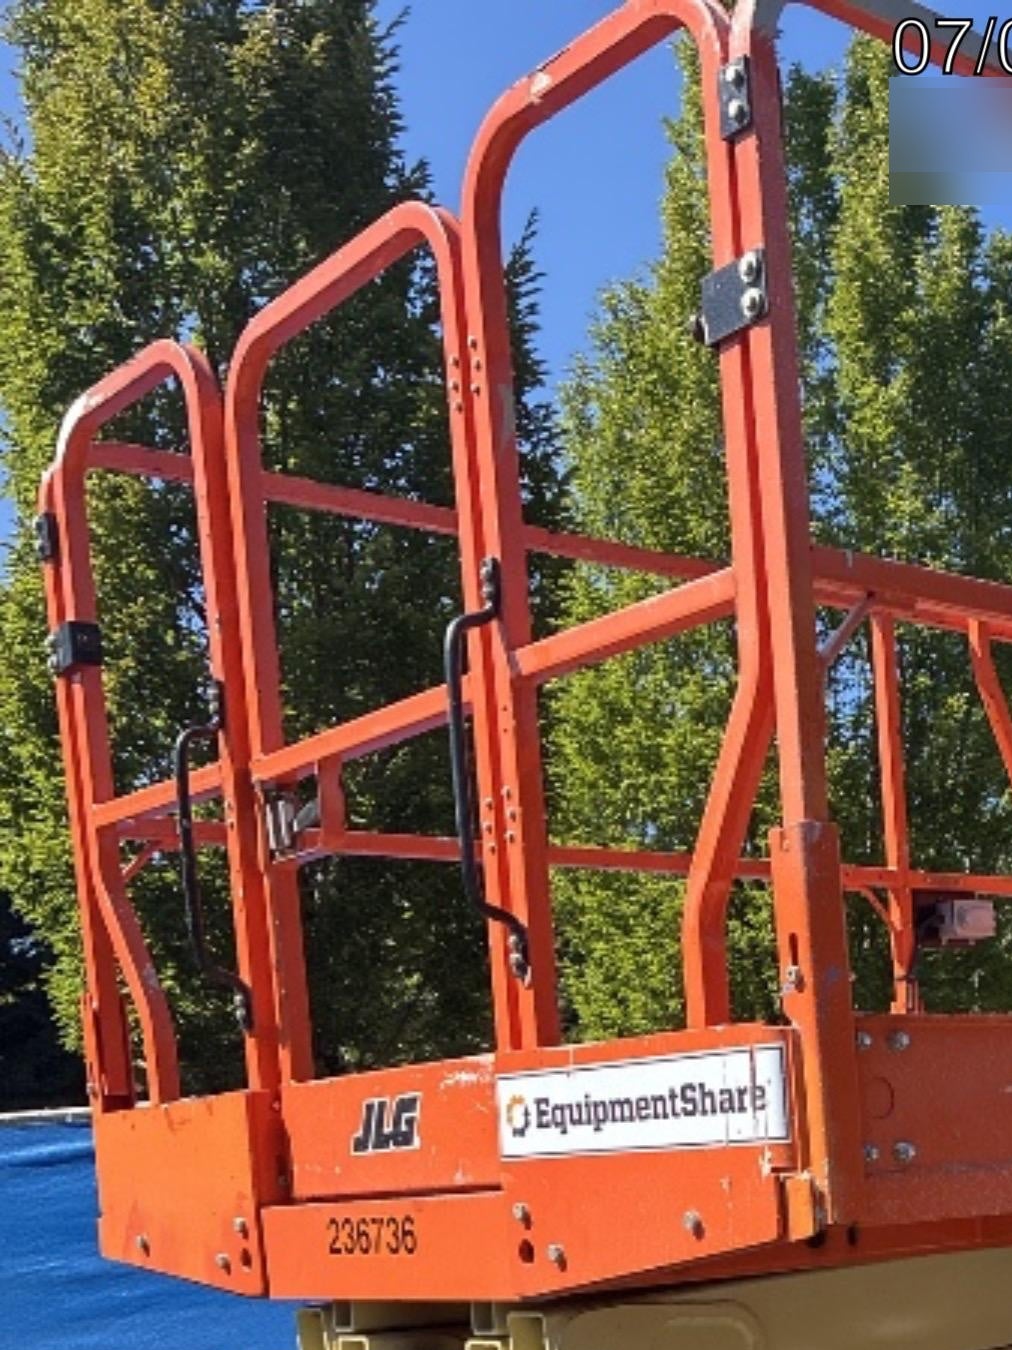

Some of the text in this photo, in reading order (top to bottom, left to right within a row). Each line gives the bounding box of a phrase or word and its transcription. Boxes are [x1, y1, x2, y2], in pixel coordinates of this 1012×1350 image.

[351, 1091, 423, 1156] JLG
[535, 1082, 767, 1134] EquipmentShare
[326, 1215, 418, 1255] 236736
